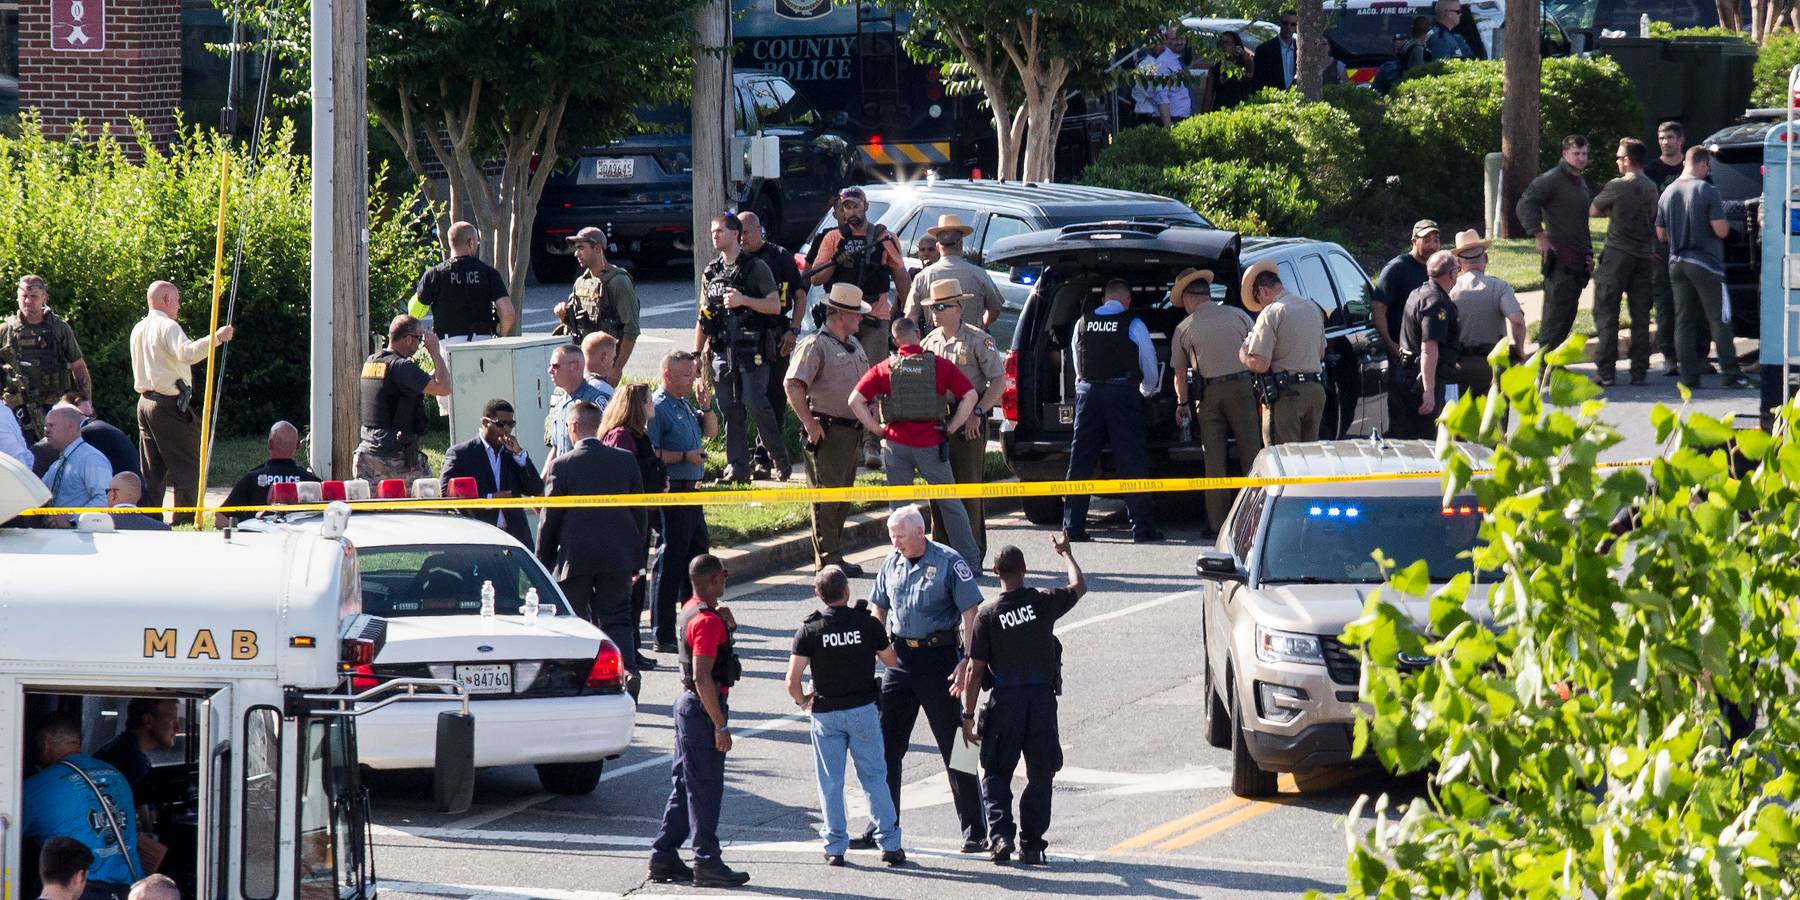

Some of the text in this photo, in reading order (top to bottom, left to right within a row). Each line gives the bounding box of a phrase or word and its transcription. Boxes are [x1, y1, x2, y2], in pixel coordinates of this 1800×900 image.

[753, 37, 856, 60] COUNTY
[763, 59, 852, 80] POLICE
[450, 271, 480, 285] POICE
[1087, 321, 1118, 332] POLICE
[267, 475, 301, 485] POLICE
[999, 605, 1037, 629] POLICE
[143, 627, 259, 660] MAB
[822, 630, 862, 647] POLICE
[473, 672, 509, 687] 84760
